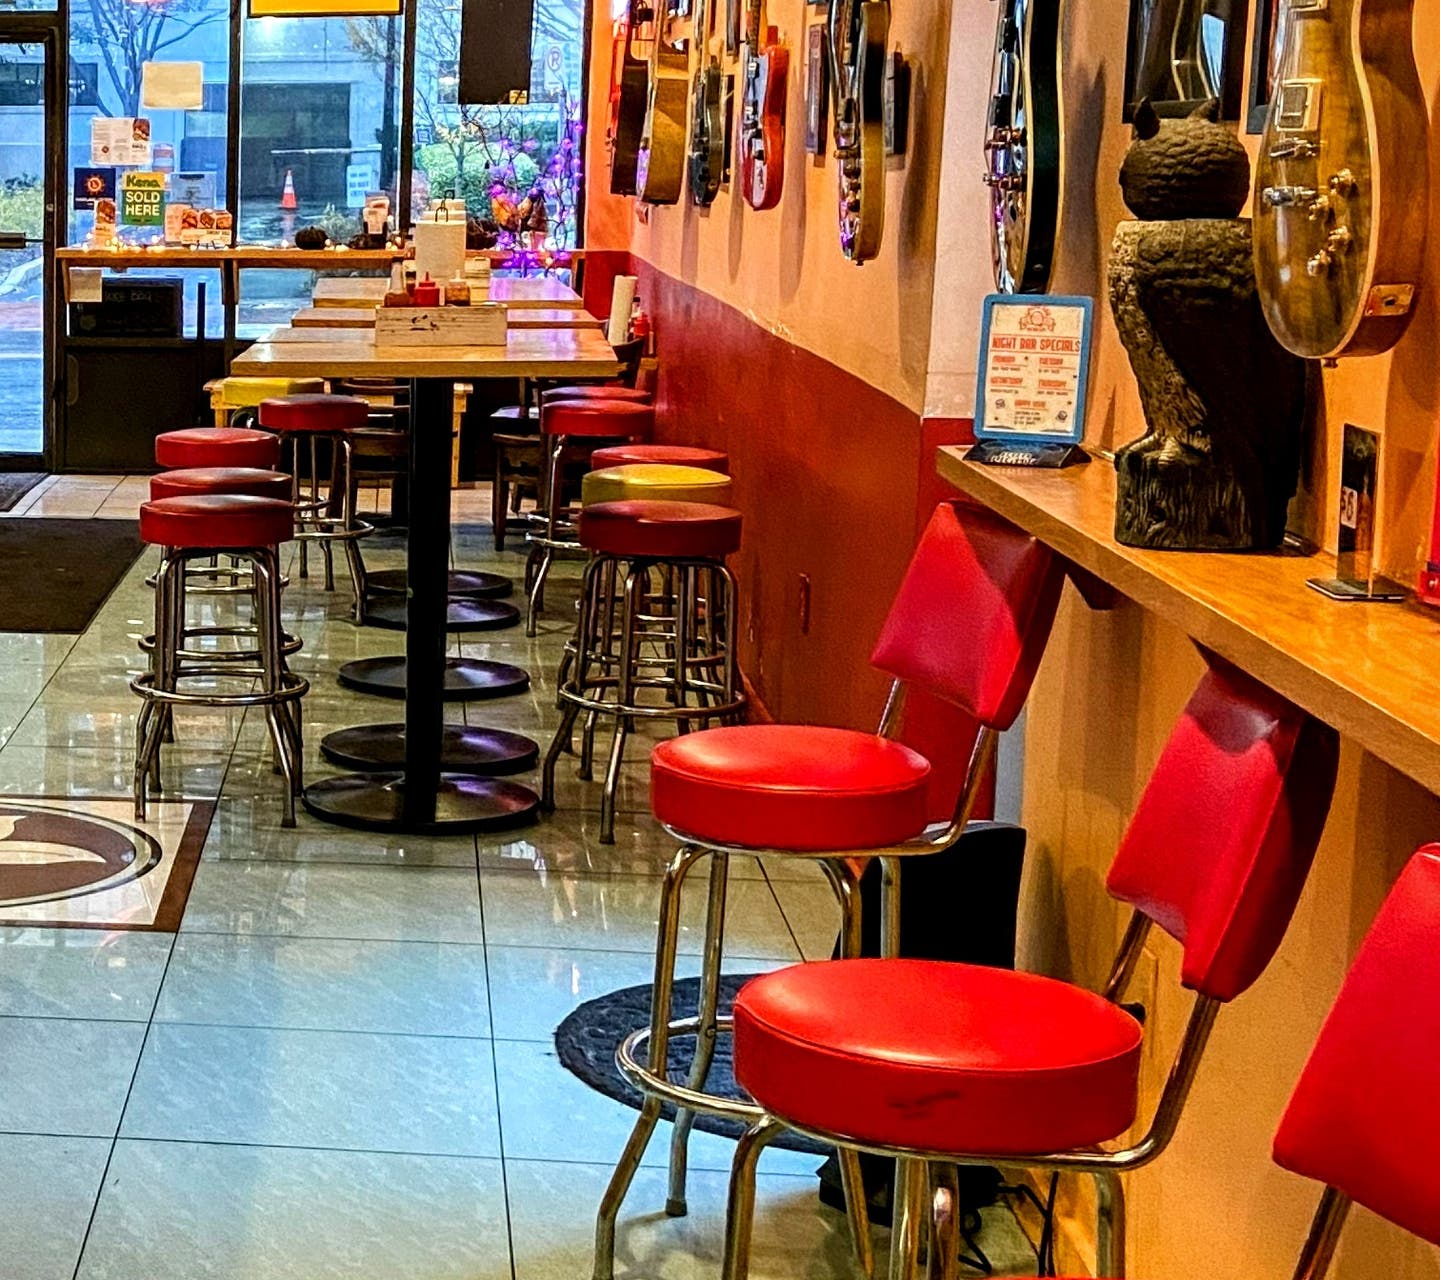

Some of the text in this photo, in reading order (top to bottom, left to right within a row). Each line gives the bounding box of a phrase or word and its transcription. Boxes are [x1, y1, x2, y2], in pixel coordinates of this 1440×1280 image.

[125, 191, 160, 203] SOLD
[125, 204, 160, 216] HERE
[1040, 339, 1081, 352] SPECIALS
